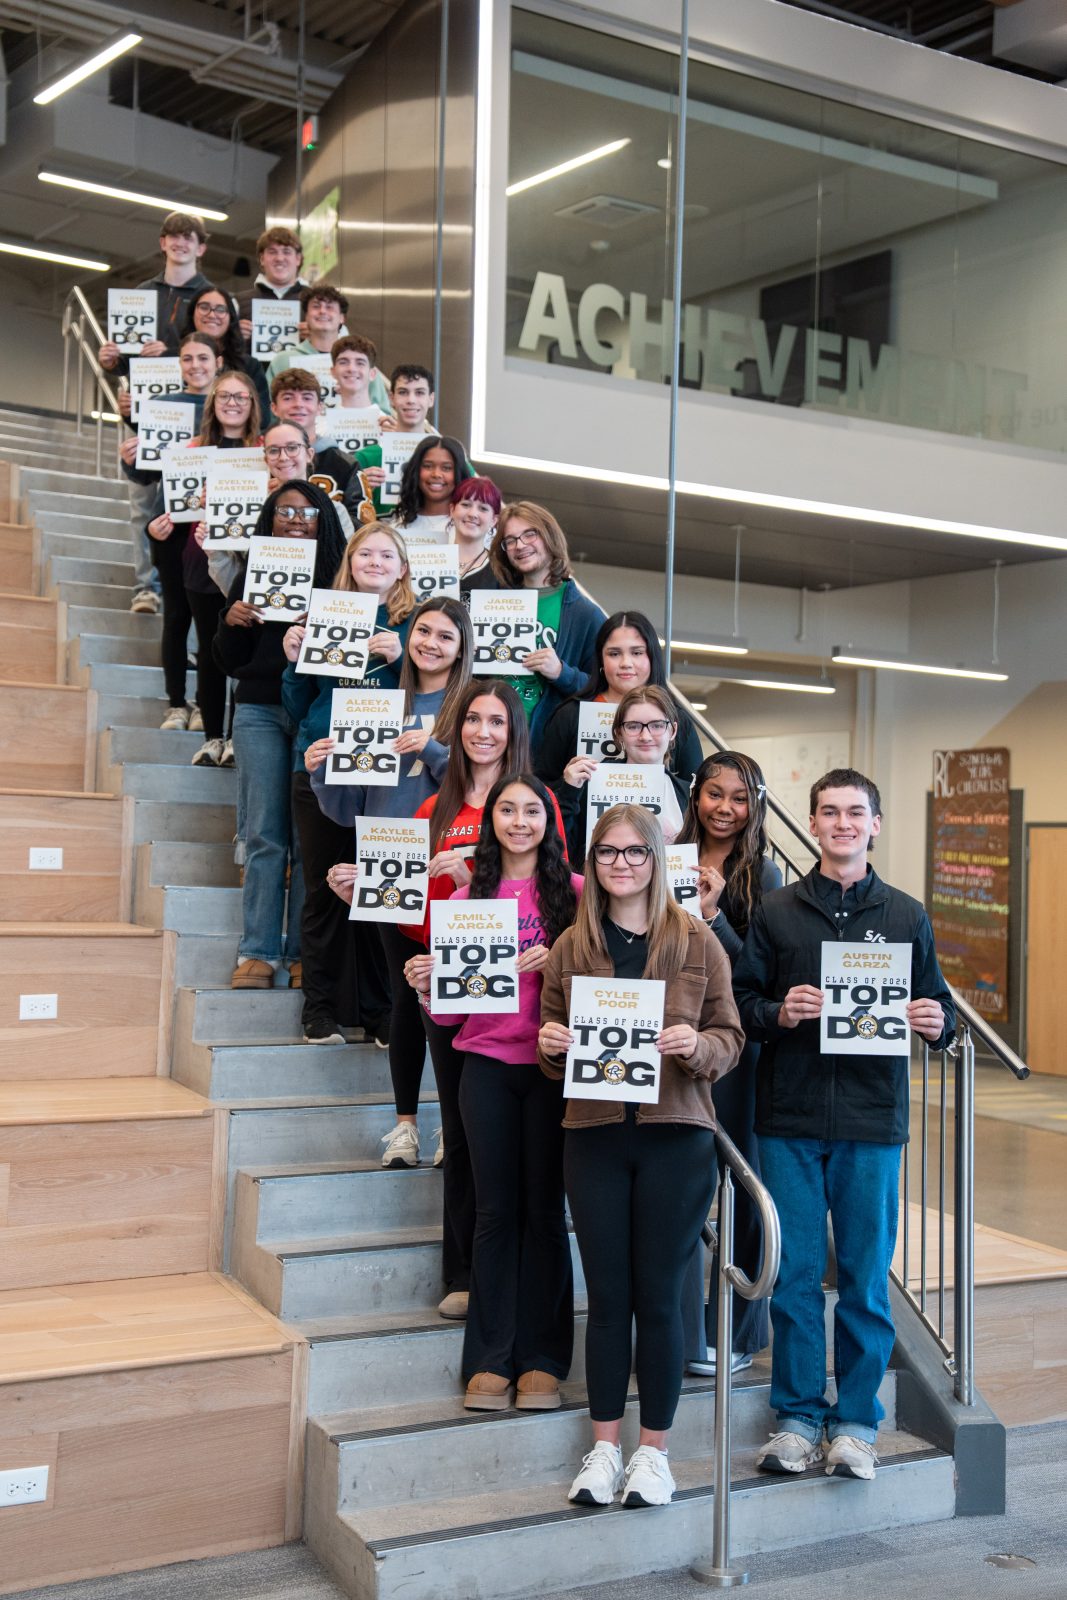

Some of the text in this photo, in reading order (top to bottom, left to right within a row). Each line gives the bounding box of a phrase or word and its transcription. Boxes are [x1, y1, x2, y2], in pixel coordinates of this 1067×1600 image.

[110, 315, 154, 326] TOP
[255, 325, 298, 336] TOP
[133, 384, 180, 394] TOP
[141, 428, 192, 442] TOP
[170, 494, 206, 512] DO
[209, 503, 264, 516] TOP
[250, 570, 311, 586] TOP
[411, 576, 457, 590] OP
[248, 592, 307, 612] DOG
[323, 606, 364, 615] MEDLIN
[310, 623, 371, 642] TOP
[473, 623, 534, 637] TOP
[303, 647, 364, 668] DOG
[473, 646, 532, 663] DOG
[339, 678, 381, 687] COZUMEL
[333, 727, 399, 744] TOP
[581, 738, 623, 756] TO
[332, 753, 396, 773] DOG
[934, 751, 955, 798] RC
[591, 802, 661, 819] TP
[362, 835, 425, 844] ARROWOOD
[360, 858, 427, 878] TOP
[674, 878, 696, 886] 2026
[357, 887, 424, 911] DOG
[435, 945, 516, 964] TOP
[437, 974, 515, 999] DOG
[594, 990, 640, 999] CYLEE
[825, 984, 908, 1006] TOP
[598, 1000, 637, 1008] POOR
[574, 1016, 608, 1024] CLASS
[634, 1020, 658, 1028] 2026
[827, 1015, 906, 1040] DOG
[574, 1025, 658, 1049] TOP
[572, 1058, 655, 1087] DOG
